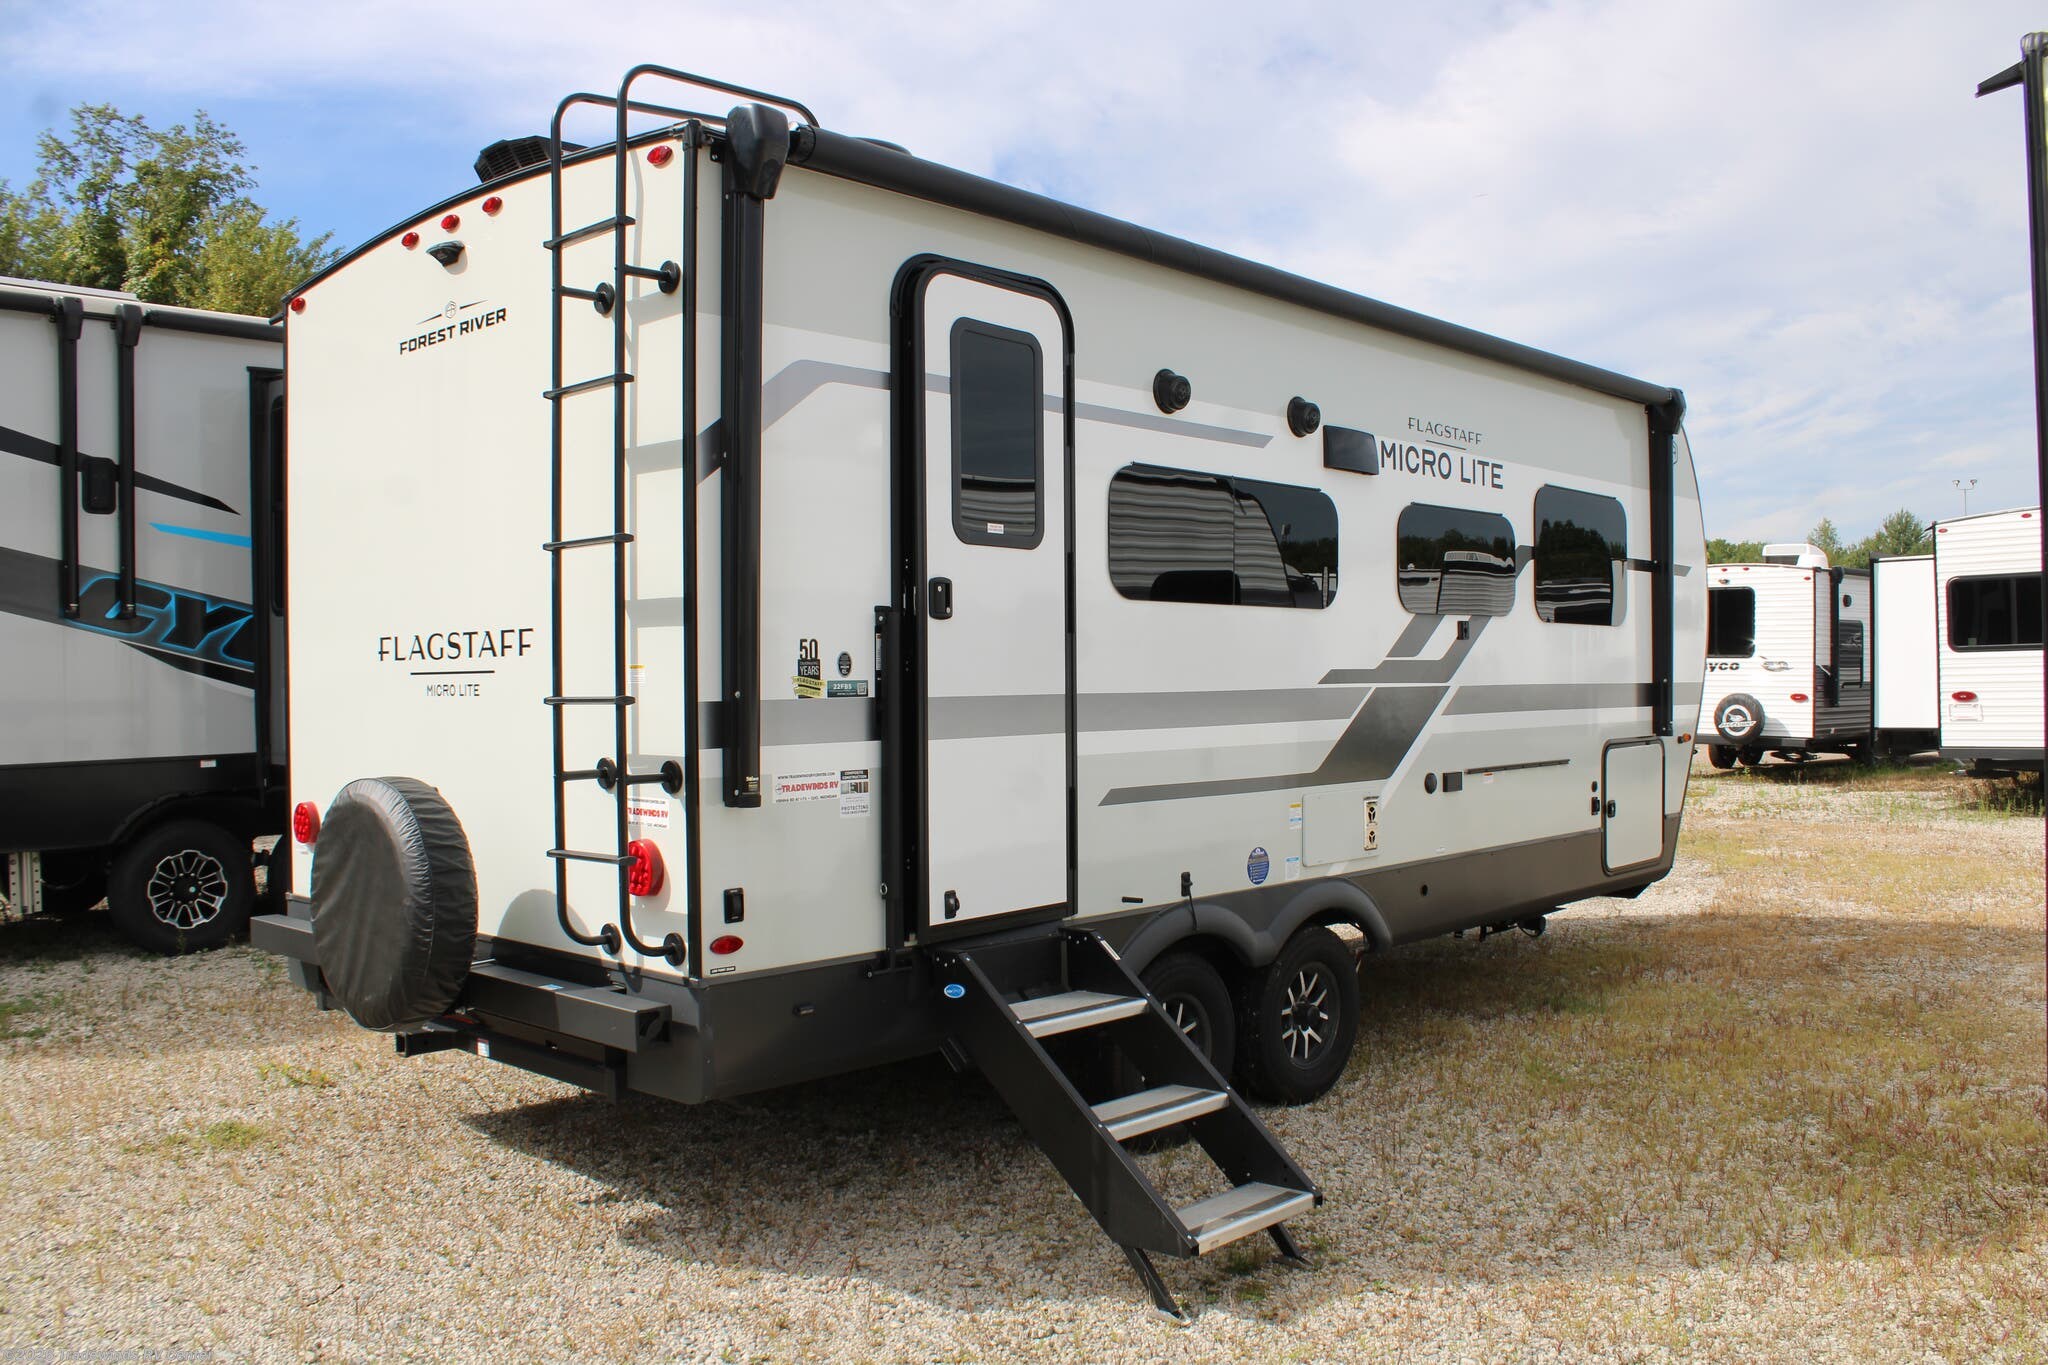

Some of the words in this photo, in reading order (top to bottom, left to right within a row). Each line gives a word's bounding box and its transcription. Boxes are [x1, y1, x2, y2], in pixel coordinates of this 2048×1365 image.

[399, 325, 456, 355] FOREST
[459, 308, 507, 336] RIVER
[1407, 417, 1483, 445] FLAGSTAFF
[1380, 440, 1452, 480] MICRO
[1460, 456, 1504, 490] LITE
[378, 628, 534, 662] FLAGSTAFF
[799, 638, 819, 660] 50
[799, 665, 820, 676] YEARS
[1705, 662, 1740, 673] yco
[426, 684, 457, 697] MICRO
[459, 683, 481, 697] LITE
[781, 782, 829, 793] TRADEWINDS
[829, 781, 839, 790] RV
[660, 810, 669, 818] RV
